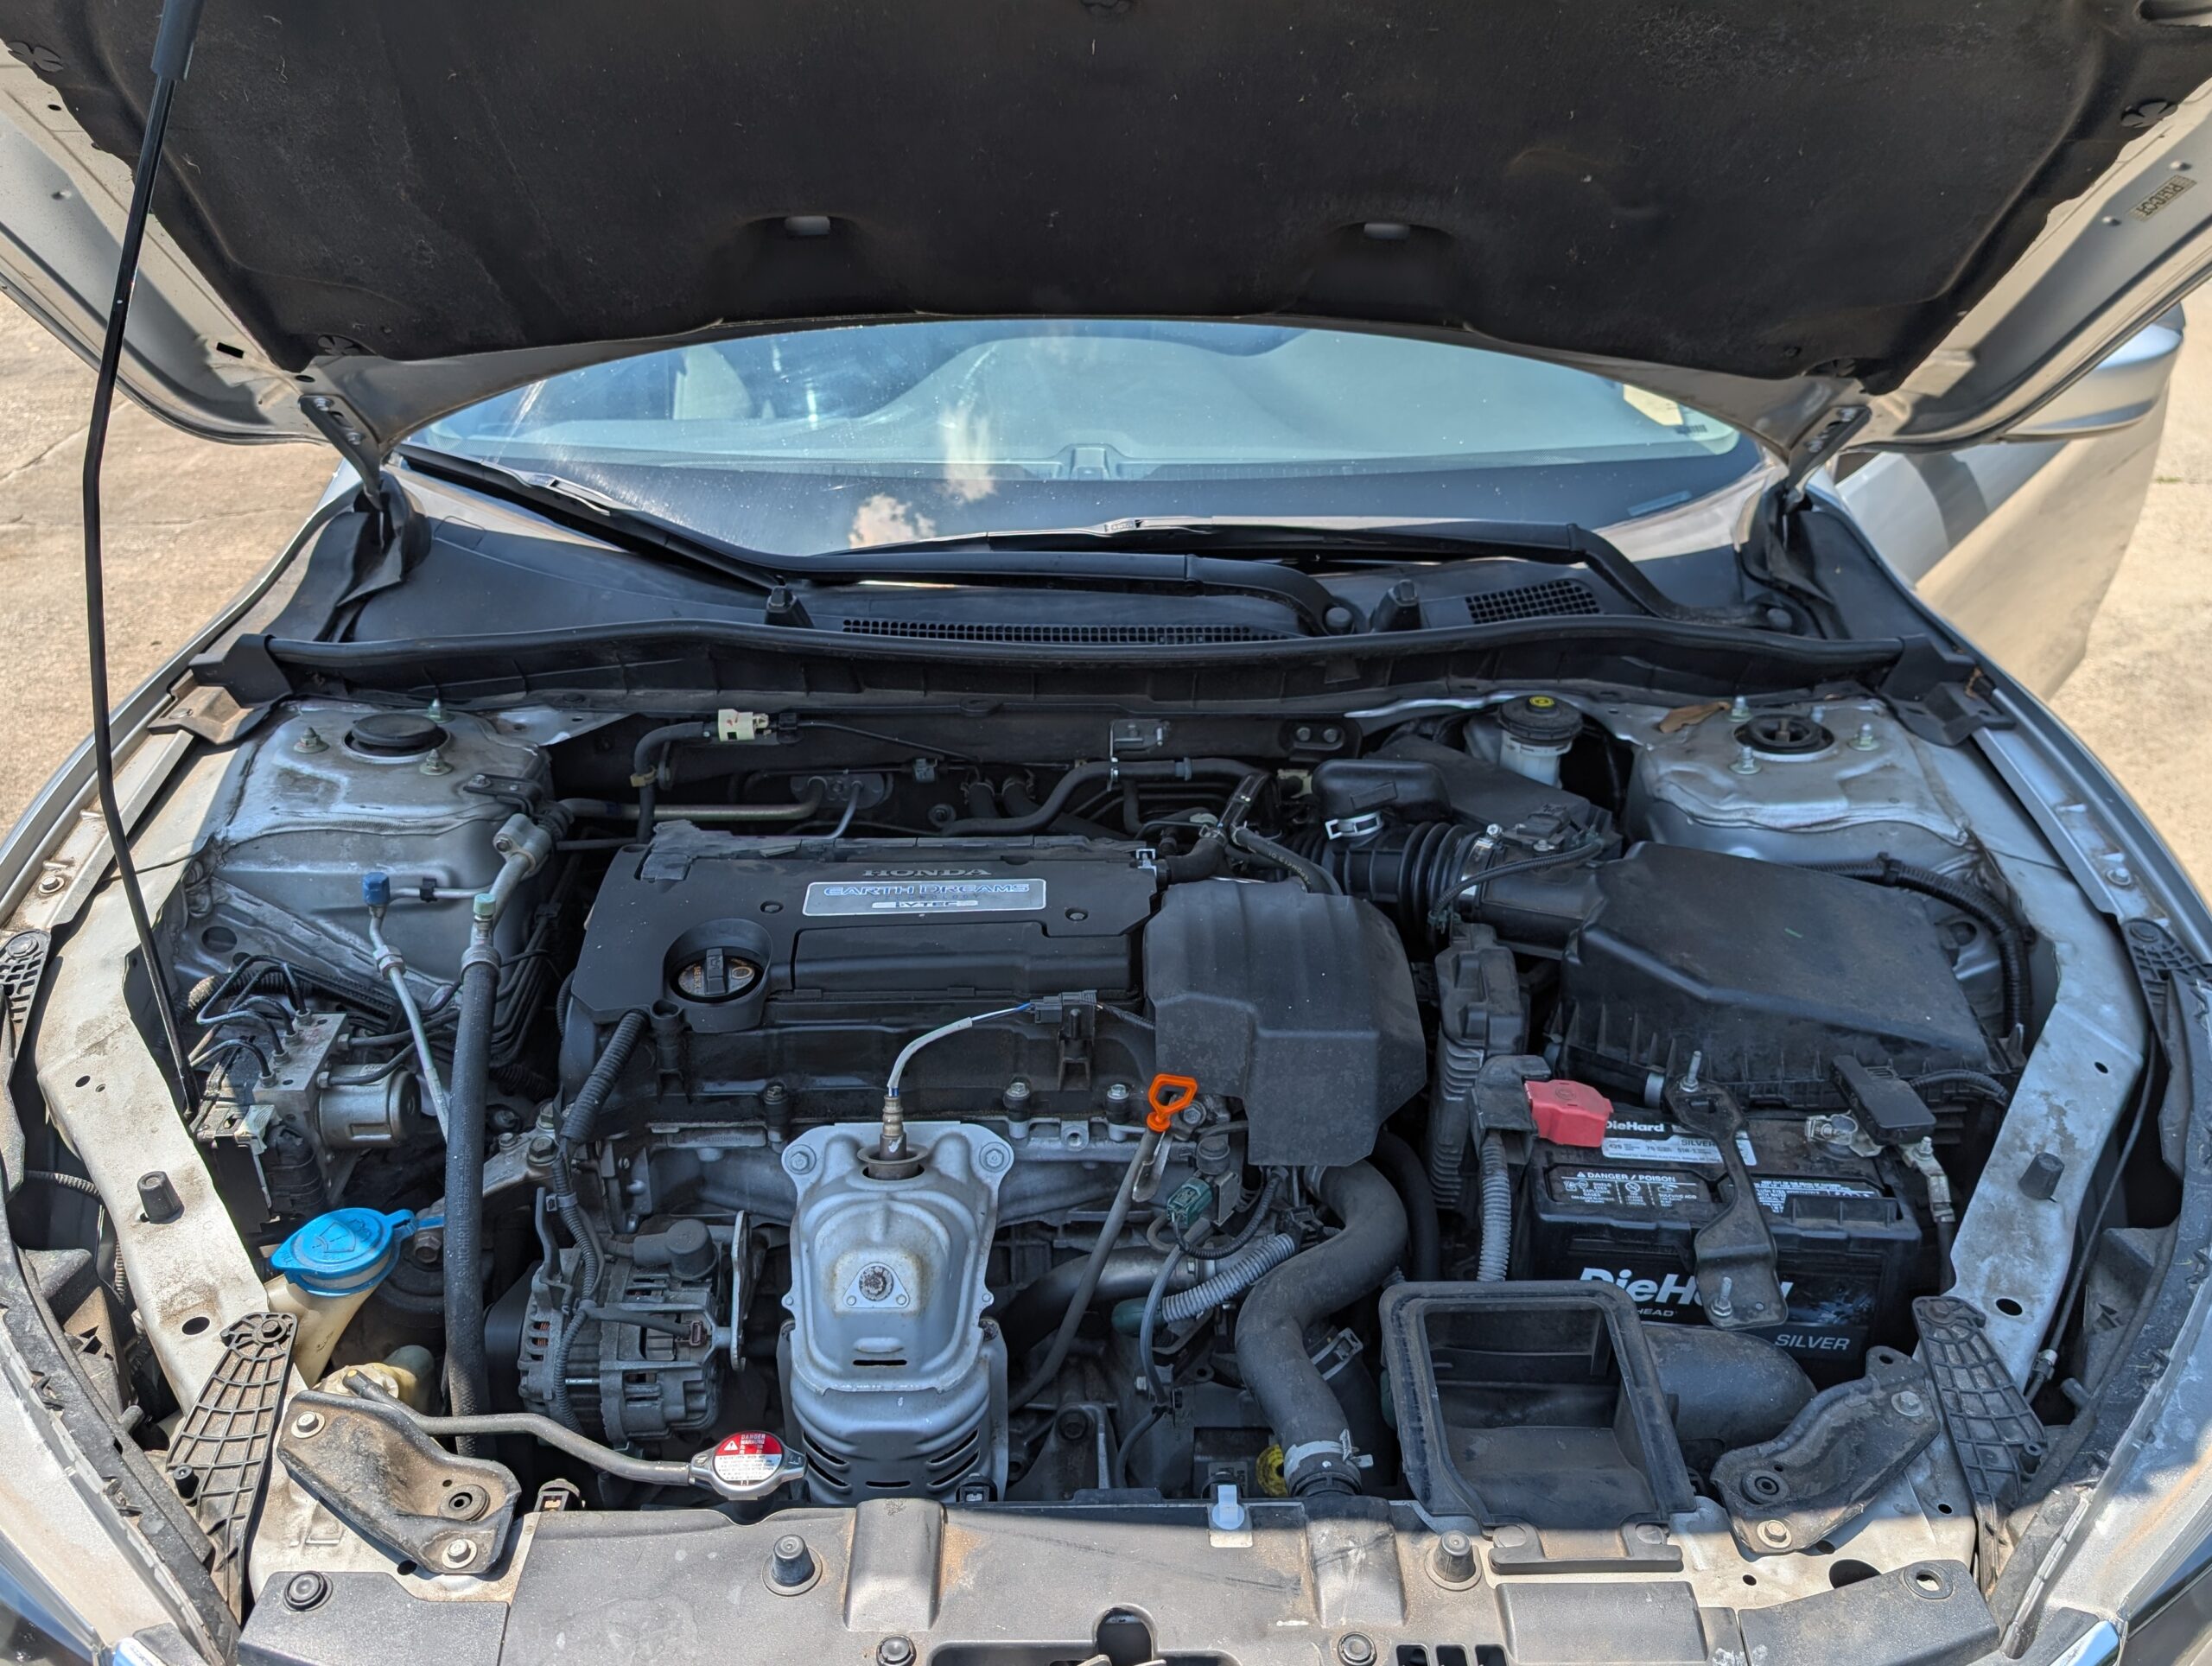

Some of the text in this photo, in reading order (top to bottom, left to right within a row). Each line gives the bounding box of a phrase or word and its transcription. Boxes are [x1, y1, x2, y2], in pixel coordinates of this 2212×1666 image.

[862, 868, 992, 877] HONDA
[823, 883, 1030, 896] EARTH DREAMS
[1605, 1121, 1665, 1132] DieHard
[1587, 1172, 1629, 1180] DANGER
[1638, 1174, 1676, 1183] POISON
[1774, 1333, 1851, 1351] SILVER
